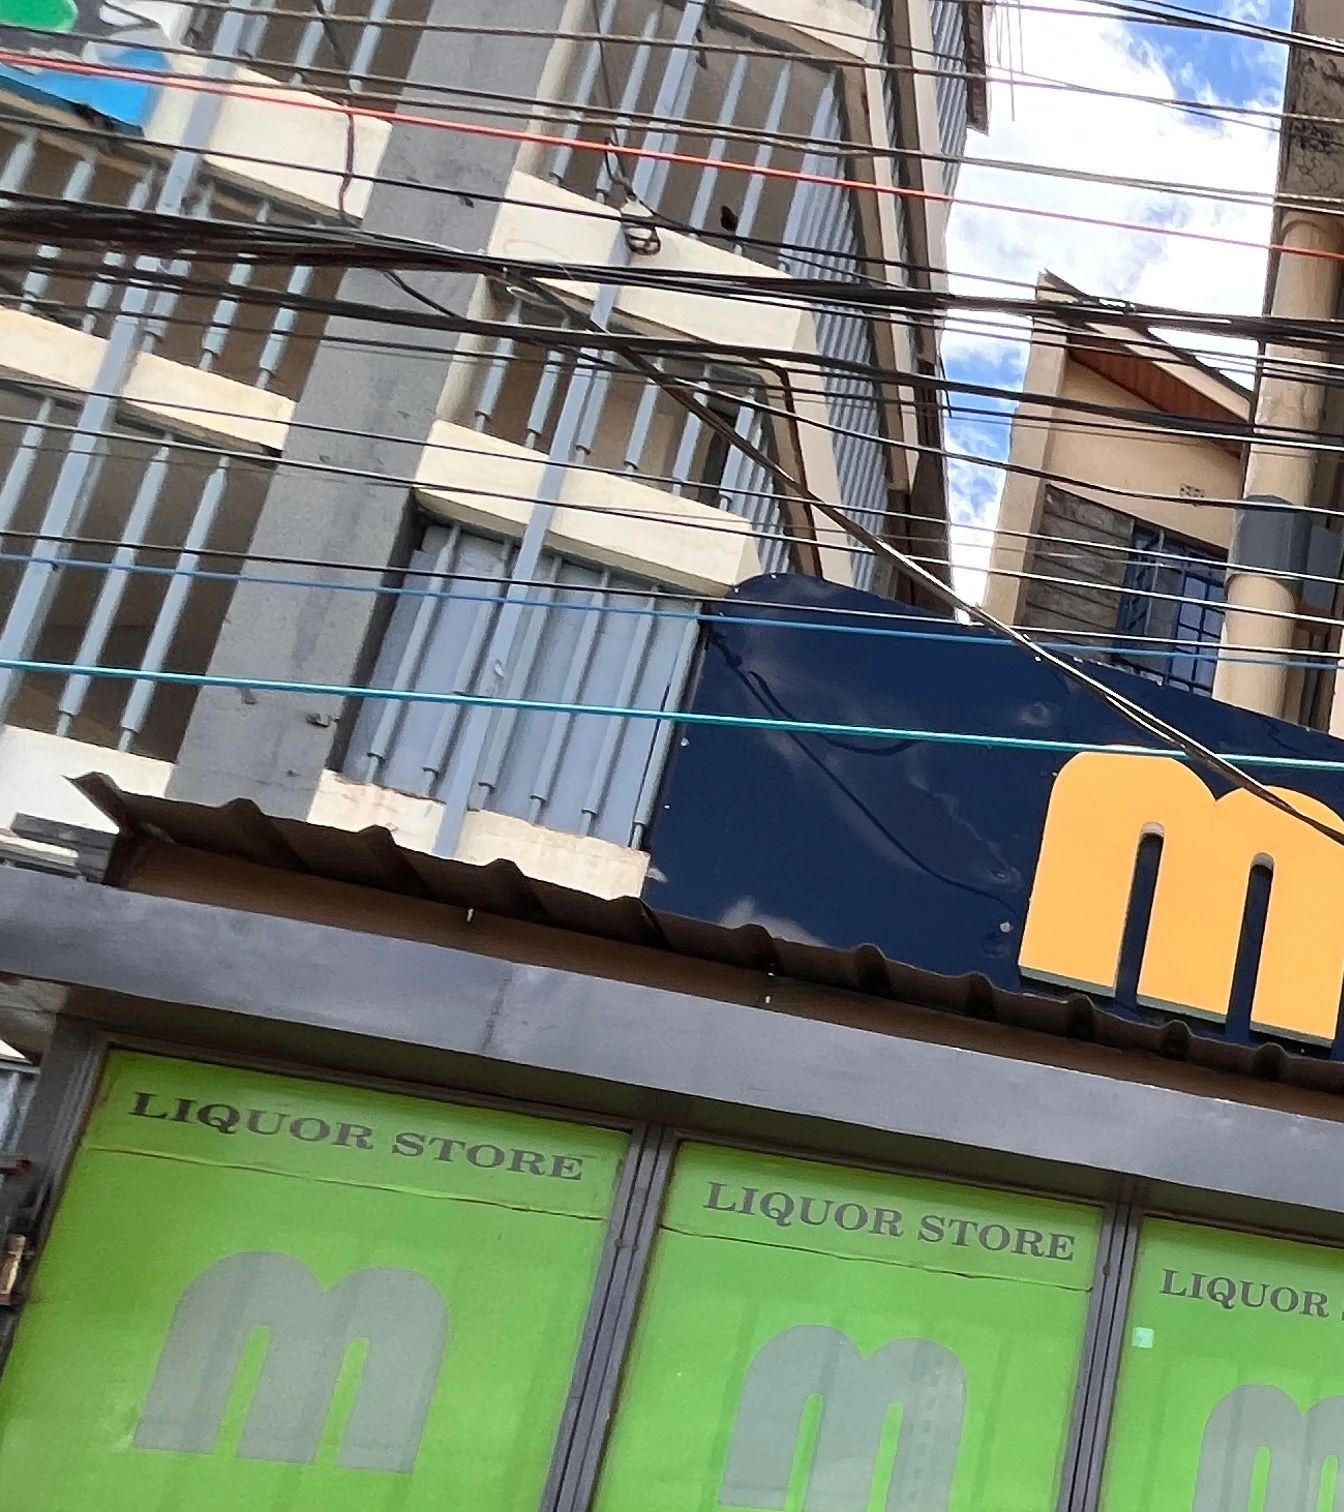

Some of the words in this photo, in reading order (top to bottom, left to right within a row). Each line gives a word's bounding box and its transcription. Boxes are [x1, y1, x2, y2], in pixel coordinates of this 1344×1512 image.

[130, 1091, 374, 1151] LIQUOR
[391, 1131, 585, 1182] STORE
[704, 1181, 904, 1238] LIQUOR
[917, 1214, 1076, 1262] STORE
[1160, 1268, 1330, 1319] LIQUOR
